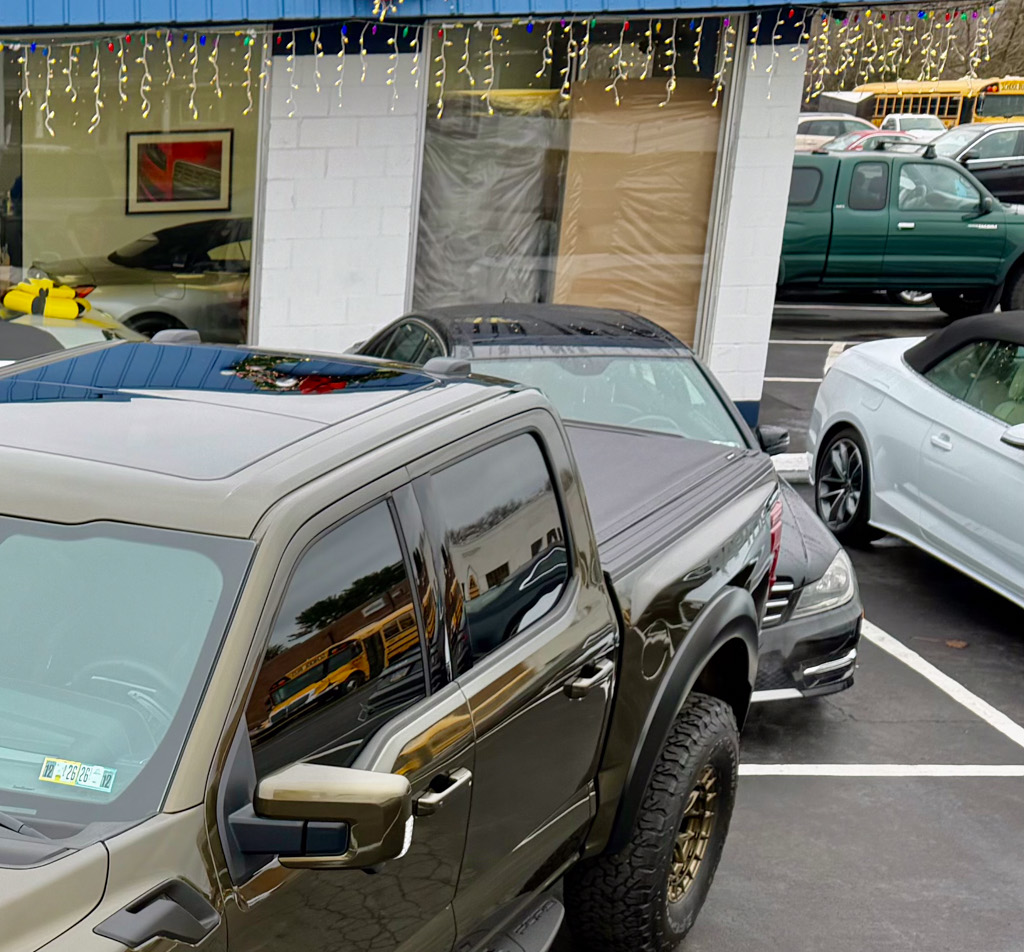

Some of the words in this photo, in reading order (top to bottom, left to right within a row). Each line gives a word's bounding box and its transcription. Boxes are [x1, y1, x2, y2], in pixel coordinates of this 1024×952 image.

[43, 764, 55, 779] 12
[66, 764, 78, 781] 26
[79, 766, 91, 782] 26
[102, 774, 113, 789] 12
